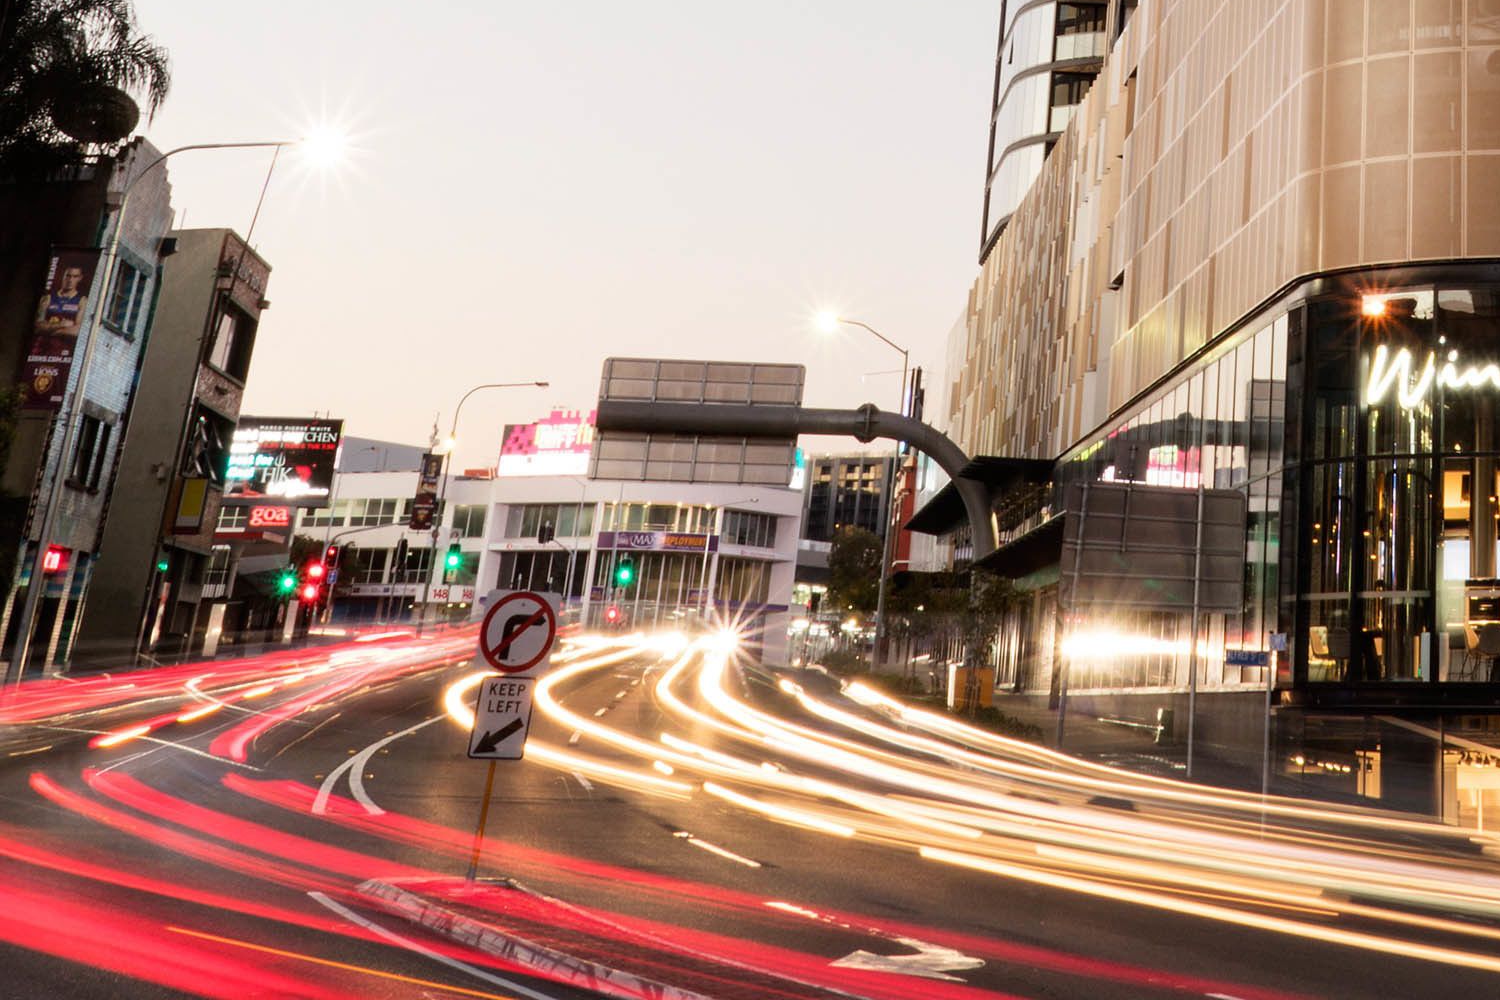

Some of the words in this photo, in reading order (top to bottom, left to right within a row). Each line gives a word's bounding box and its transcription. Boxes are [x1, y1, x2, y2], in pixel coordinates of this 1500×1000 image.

[33, 367, 59, 377] LIONS
[248, 508, 288, 526] goa
[662, 536, 707, 547] MPLOYMENT
[432, 588, 449, 599] 148
[488, 683, 527, 697] KEEP
[487, 701, 523, 713] LEFT
